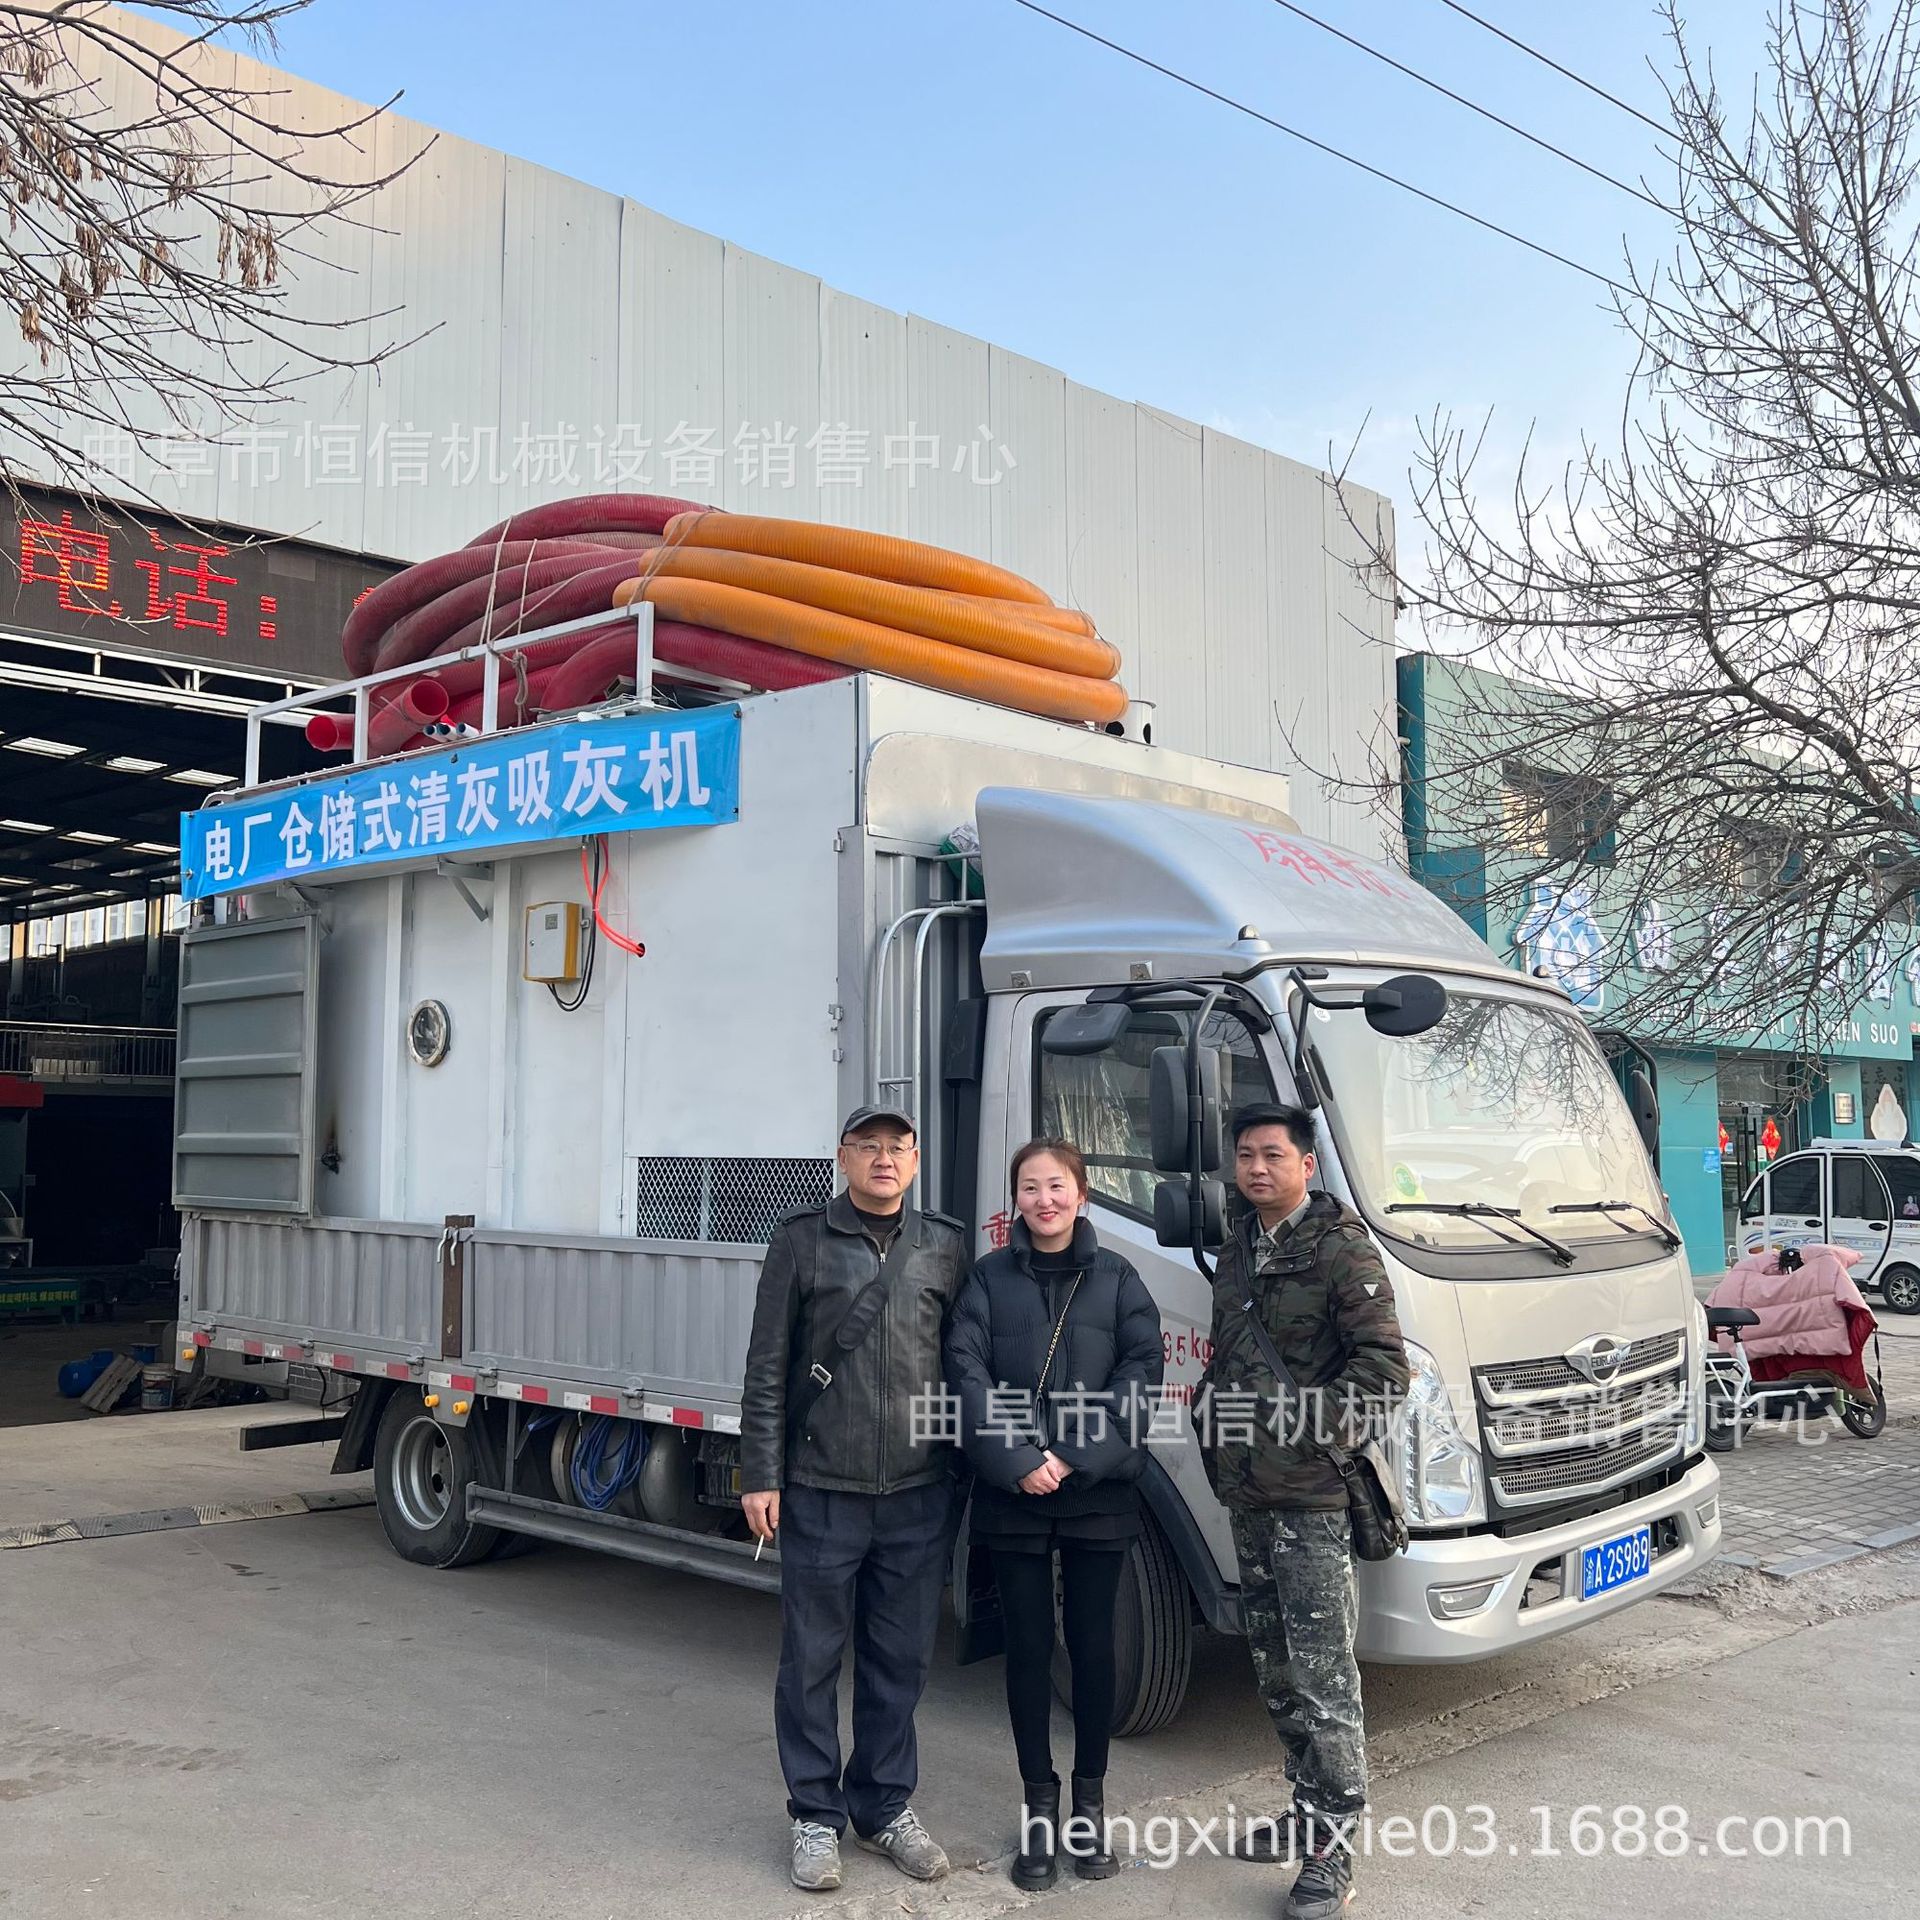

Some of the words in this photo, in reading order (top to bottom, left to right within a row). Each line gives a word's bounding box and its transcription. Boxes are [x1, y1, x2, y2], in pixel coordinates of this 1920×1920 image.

[205, 730, 710, 881] 电厂仓储式清灰吸灰机
[1870, 1022, 1899, 1045] SUO
